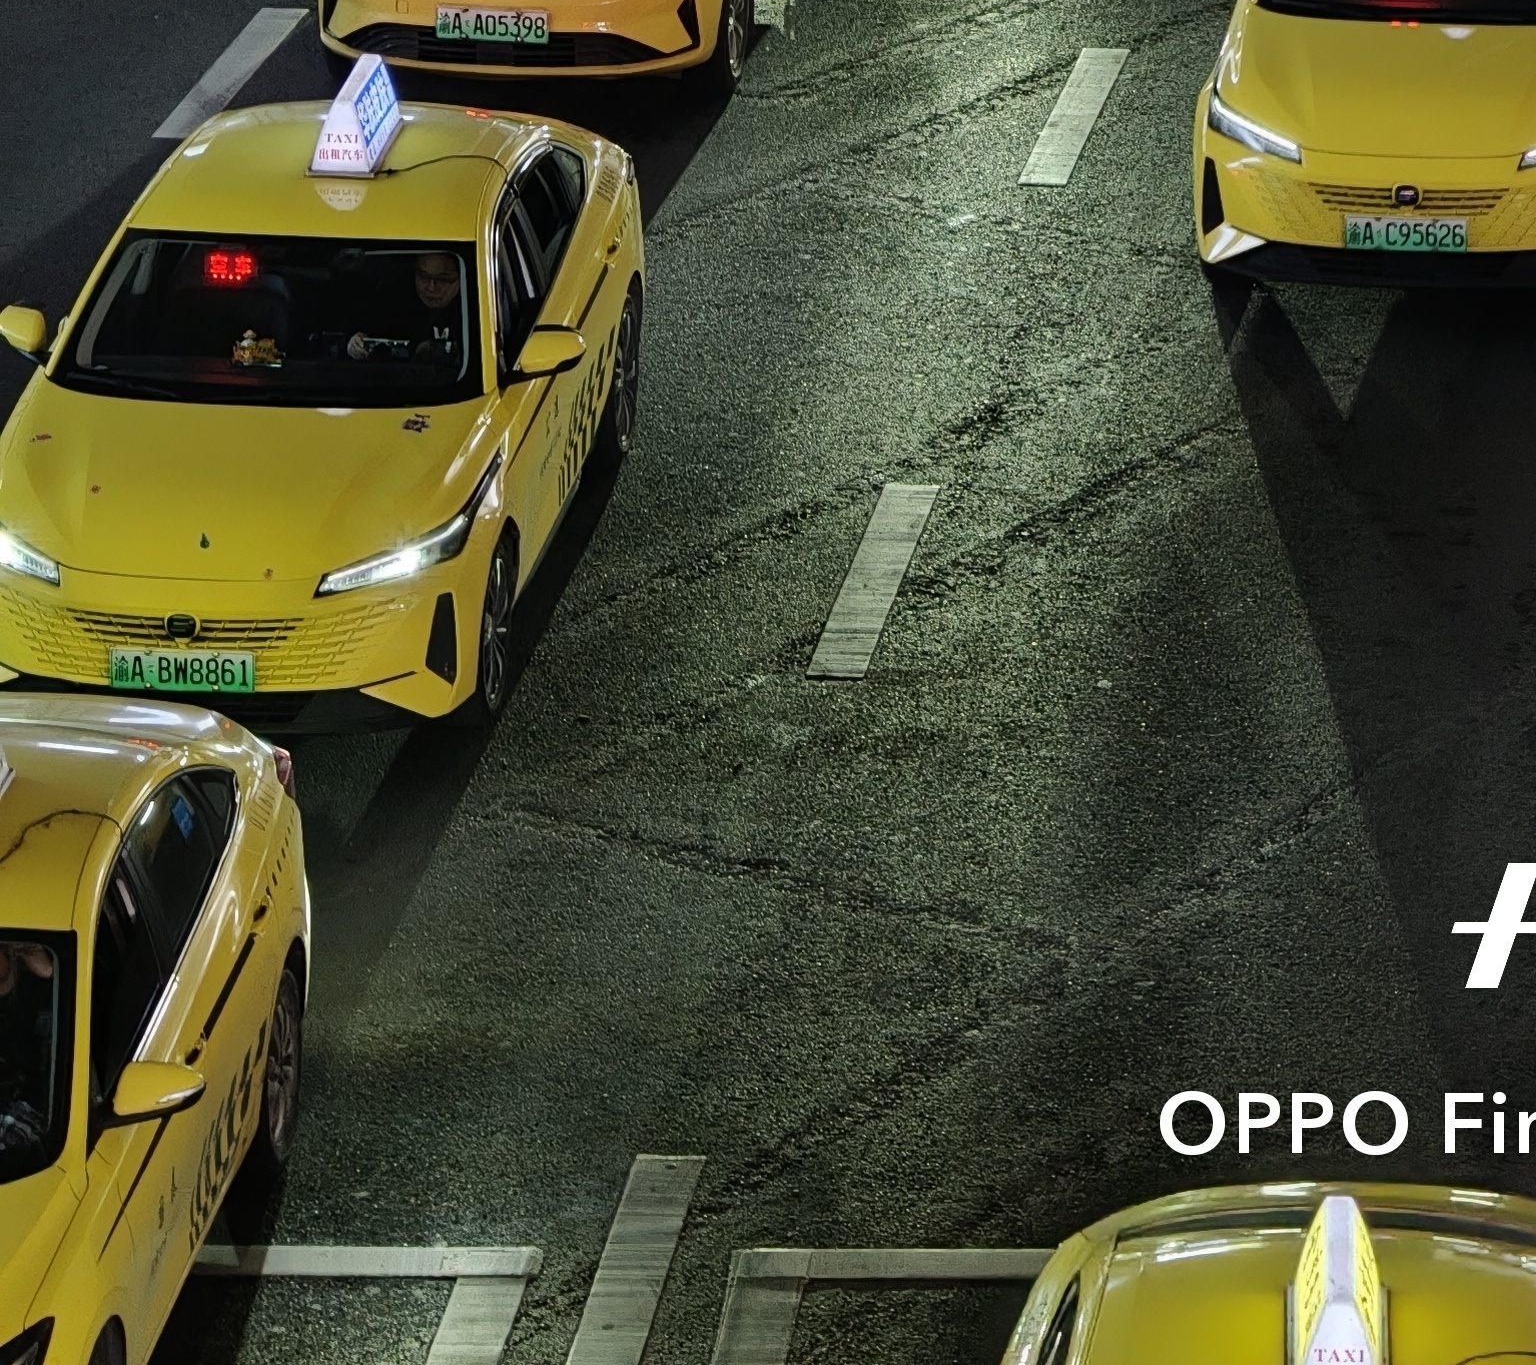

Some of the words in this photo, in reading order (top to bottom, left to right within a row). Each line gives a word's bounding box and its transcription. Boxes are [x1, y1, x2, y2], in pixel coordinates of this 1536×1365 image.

[324, 133, 358, 144] TAXI
[318, 148, 364, 161] 出租汽车
[1314, 1348, 1365, 1363] TAXI
